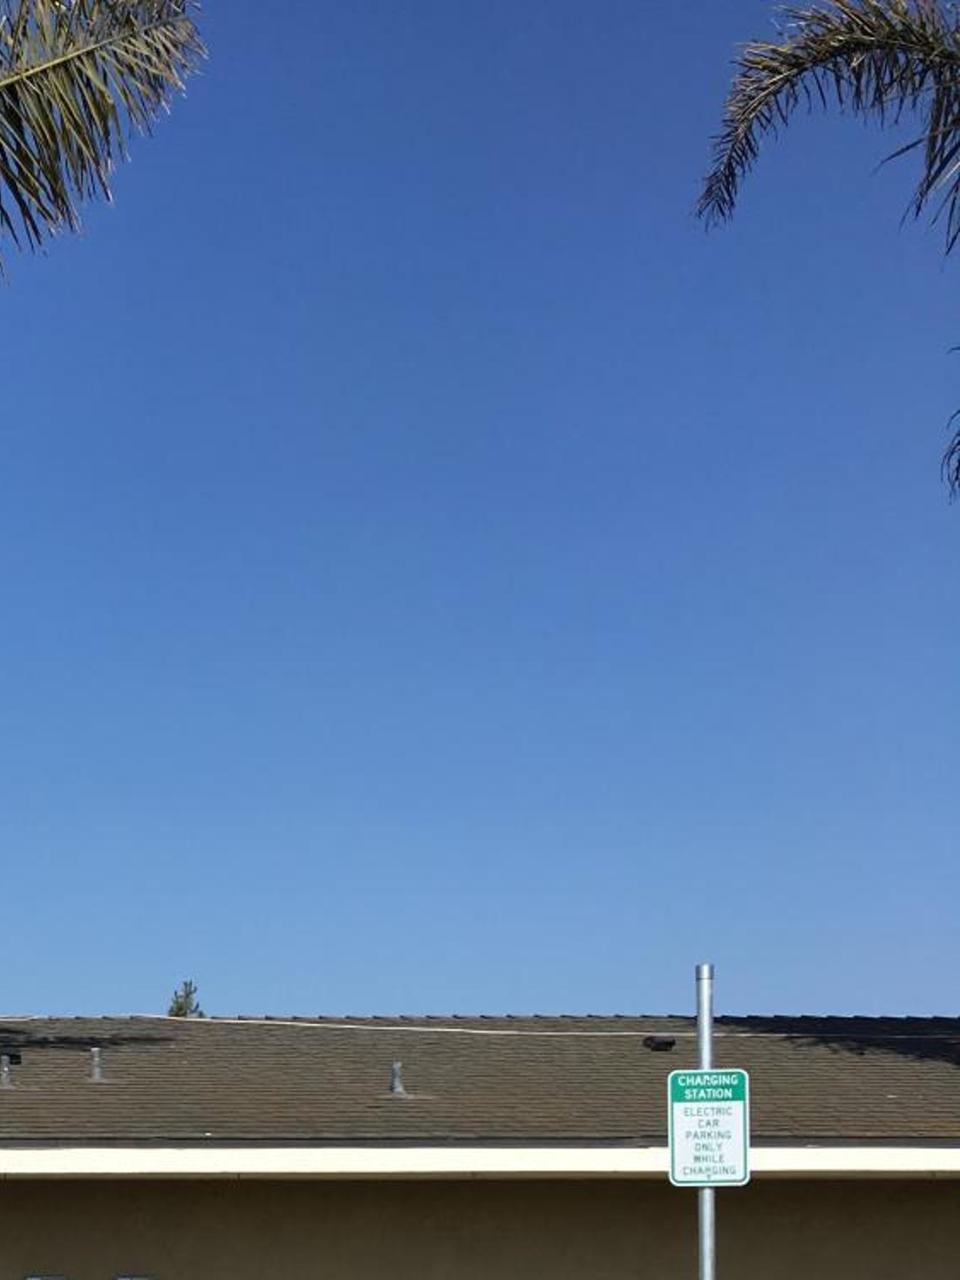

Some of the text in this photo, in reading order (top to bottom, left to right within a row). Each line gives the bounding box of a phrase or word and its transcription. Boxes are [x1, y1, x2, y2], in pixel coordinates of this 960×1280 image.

[678, 1075, 738, 1086] CHARGING
[684, 1088, 732, 1099] STATION
[683, 1107, 733, 1117] ELECTRIC
[698, 1119, 719, 1129] CAR
[685, 1131, 732, 1140] PARKING
[695, 1143, 722, 1152] ONLY
[694, 1154, 725, 1164] WHILE
[683, 1166, 736, 1176] CHARGING
